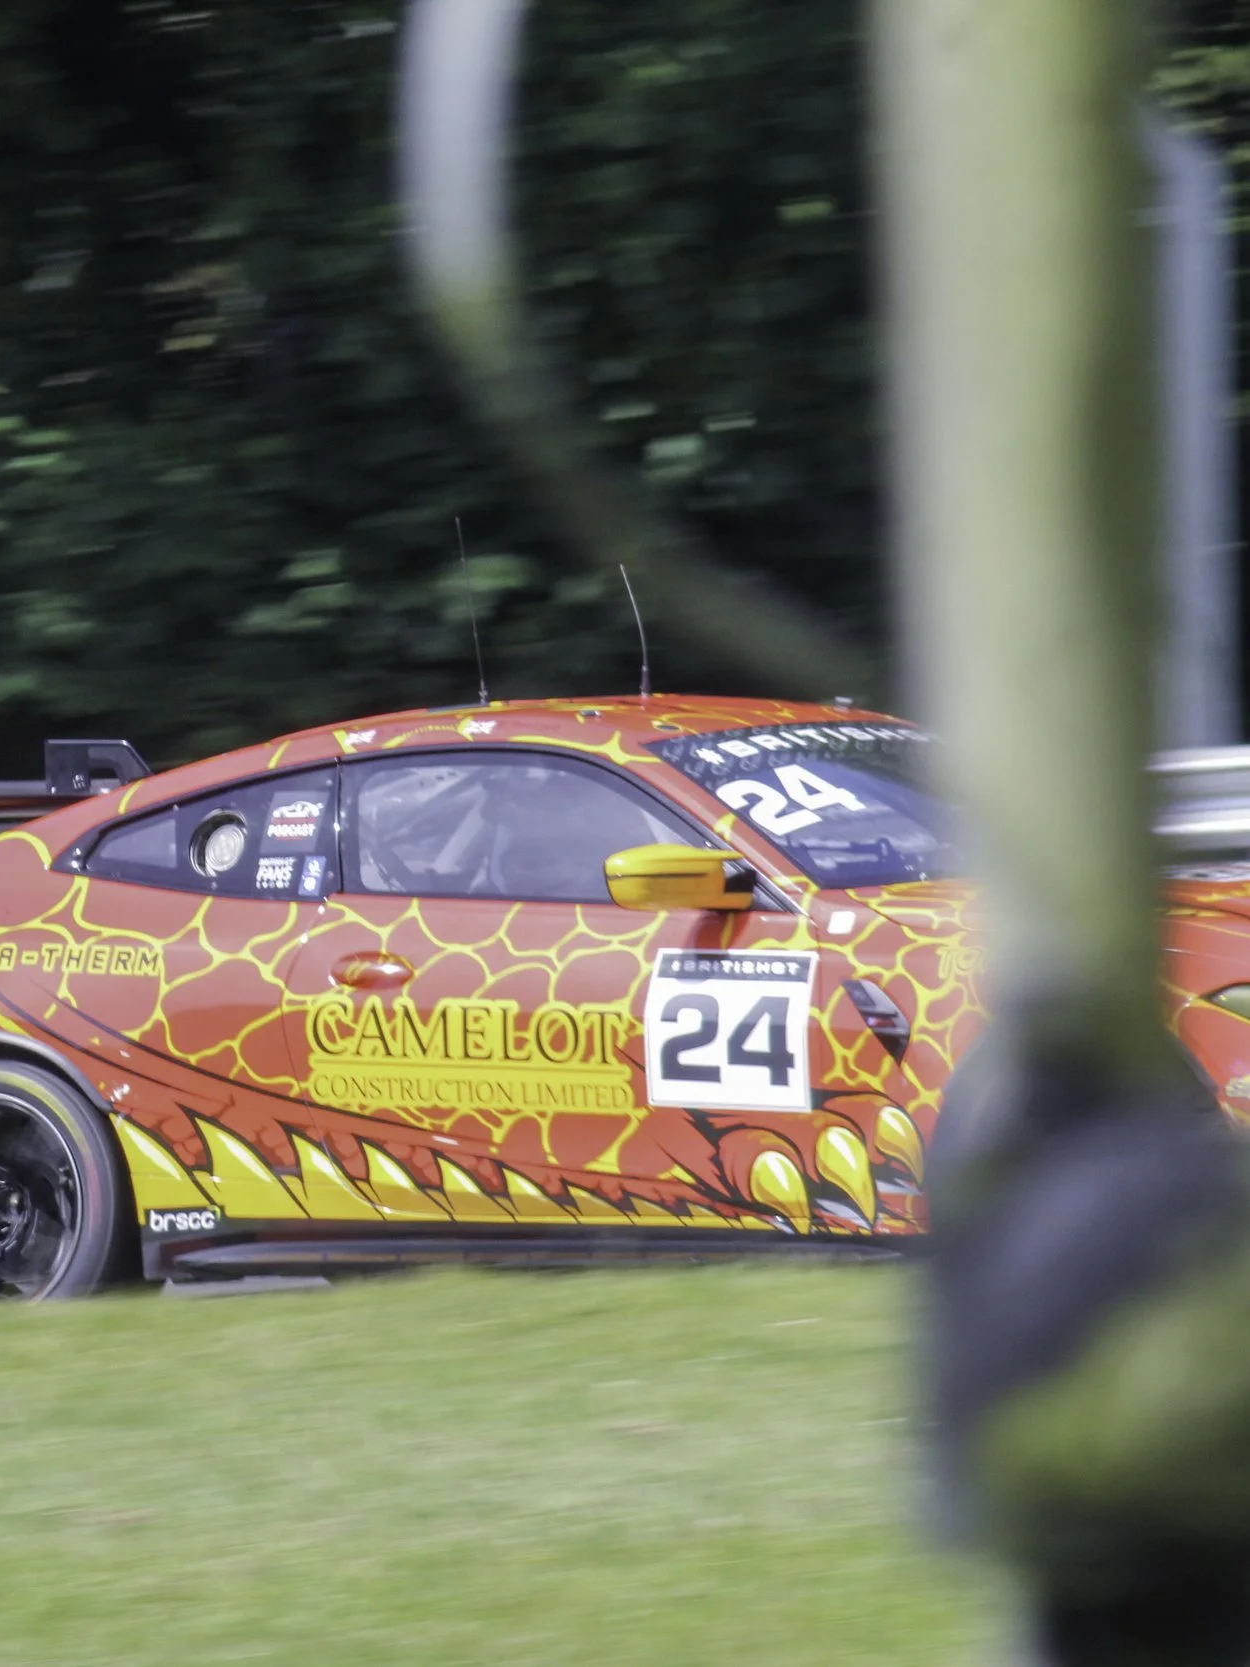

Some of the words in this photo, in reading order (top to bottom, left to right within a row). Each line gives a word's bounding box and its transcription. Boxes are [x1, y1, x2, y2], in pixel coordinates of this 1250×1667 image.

[695, 726, 942, 766] #BRITISHG
[715, 763, 867, 837] 24
[311, 1000, 624, 1065] CAMELOT
[660, 992, 796, 1087] 24
[312, 1073, 514, 1105] CONSTRUCTION
[520, 1080, 629, 1109] LIMITED
[149, 1209, 216, 1232] brscc
